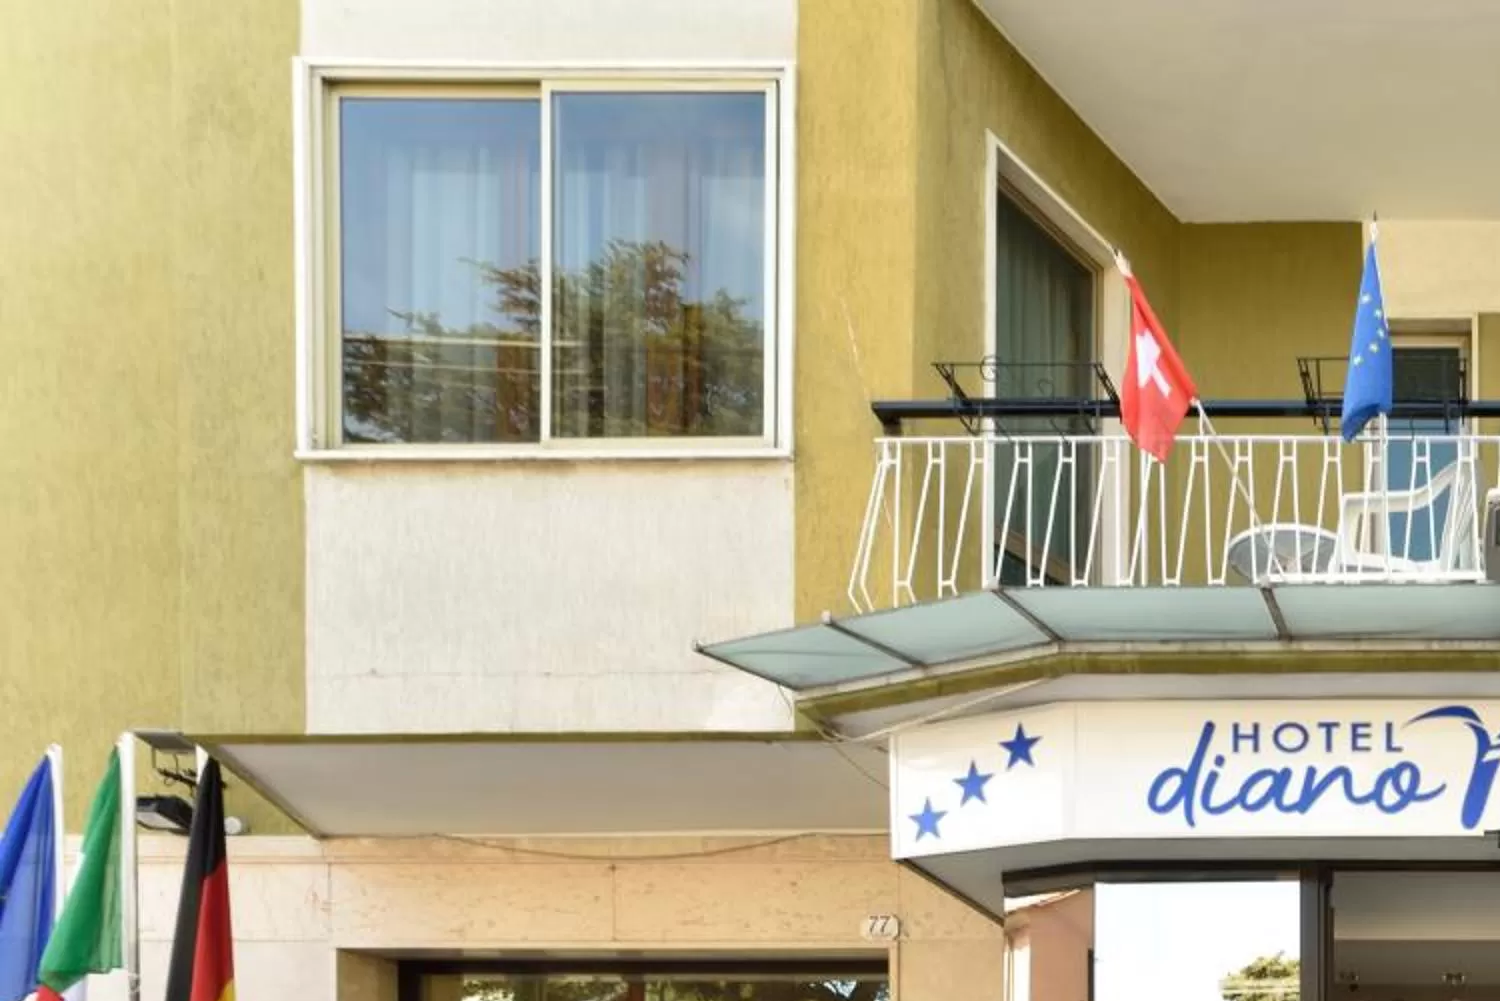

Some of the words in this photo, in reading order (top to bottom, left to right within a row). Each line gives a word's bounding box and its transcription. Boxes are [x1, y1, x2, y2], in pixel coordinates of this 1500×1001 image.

[1231, 721, 1404, 753] HOTEL
[1147, 720, 1447, 828] diano
[868, 915, 891, 933] 77
